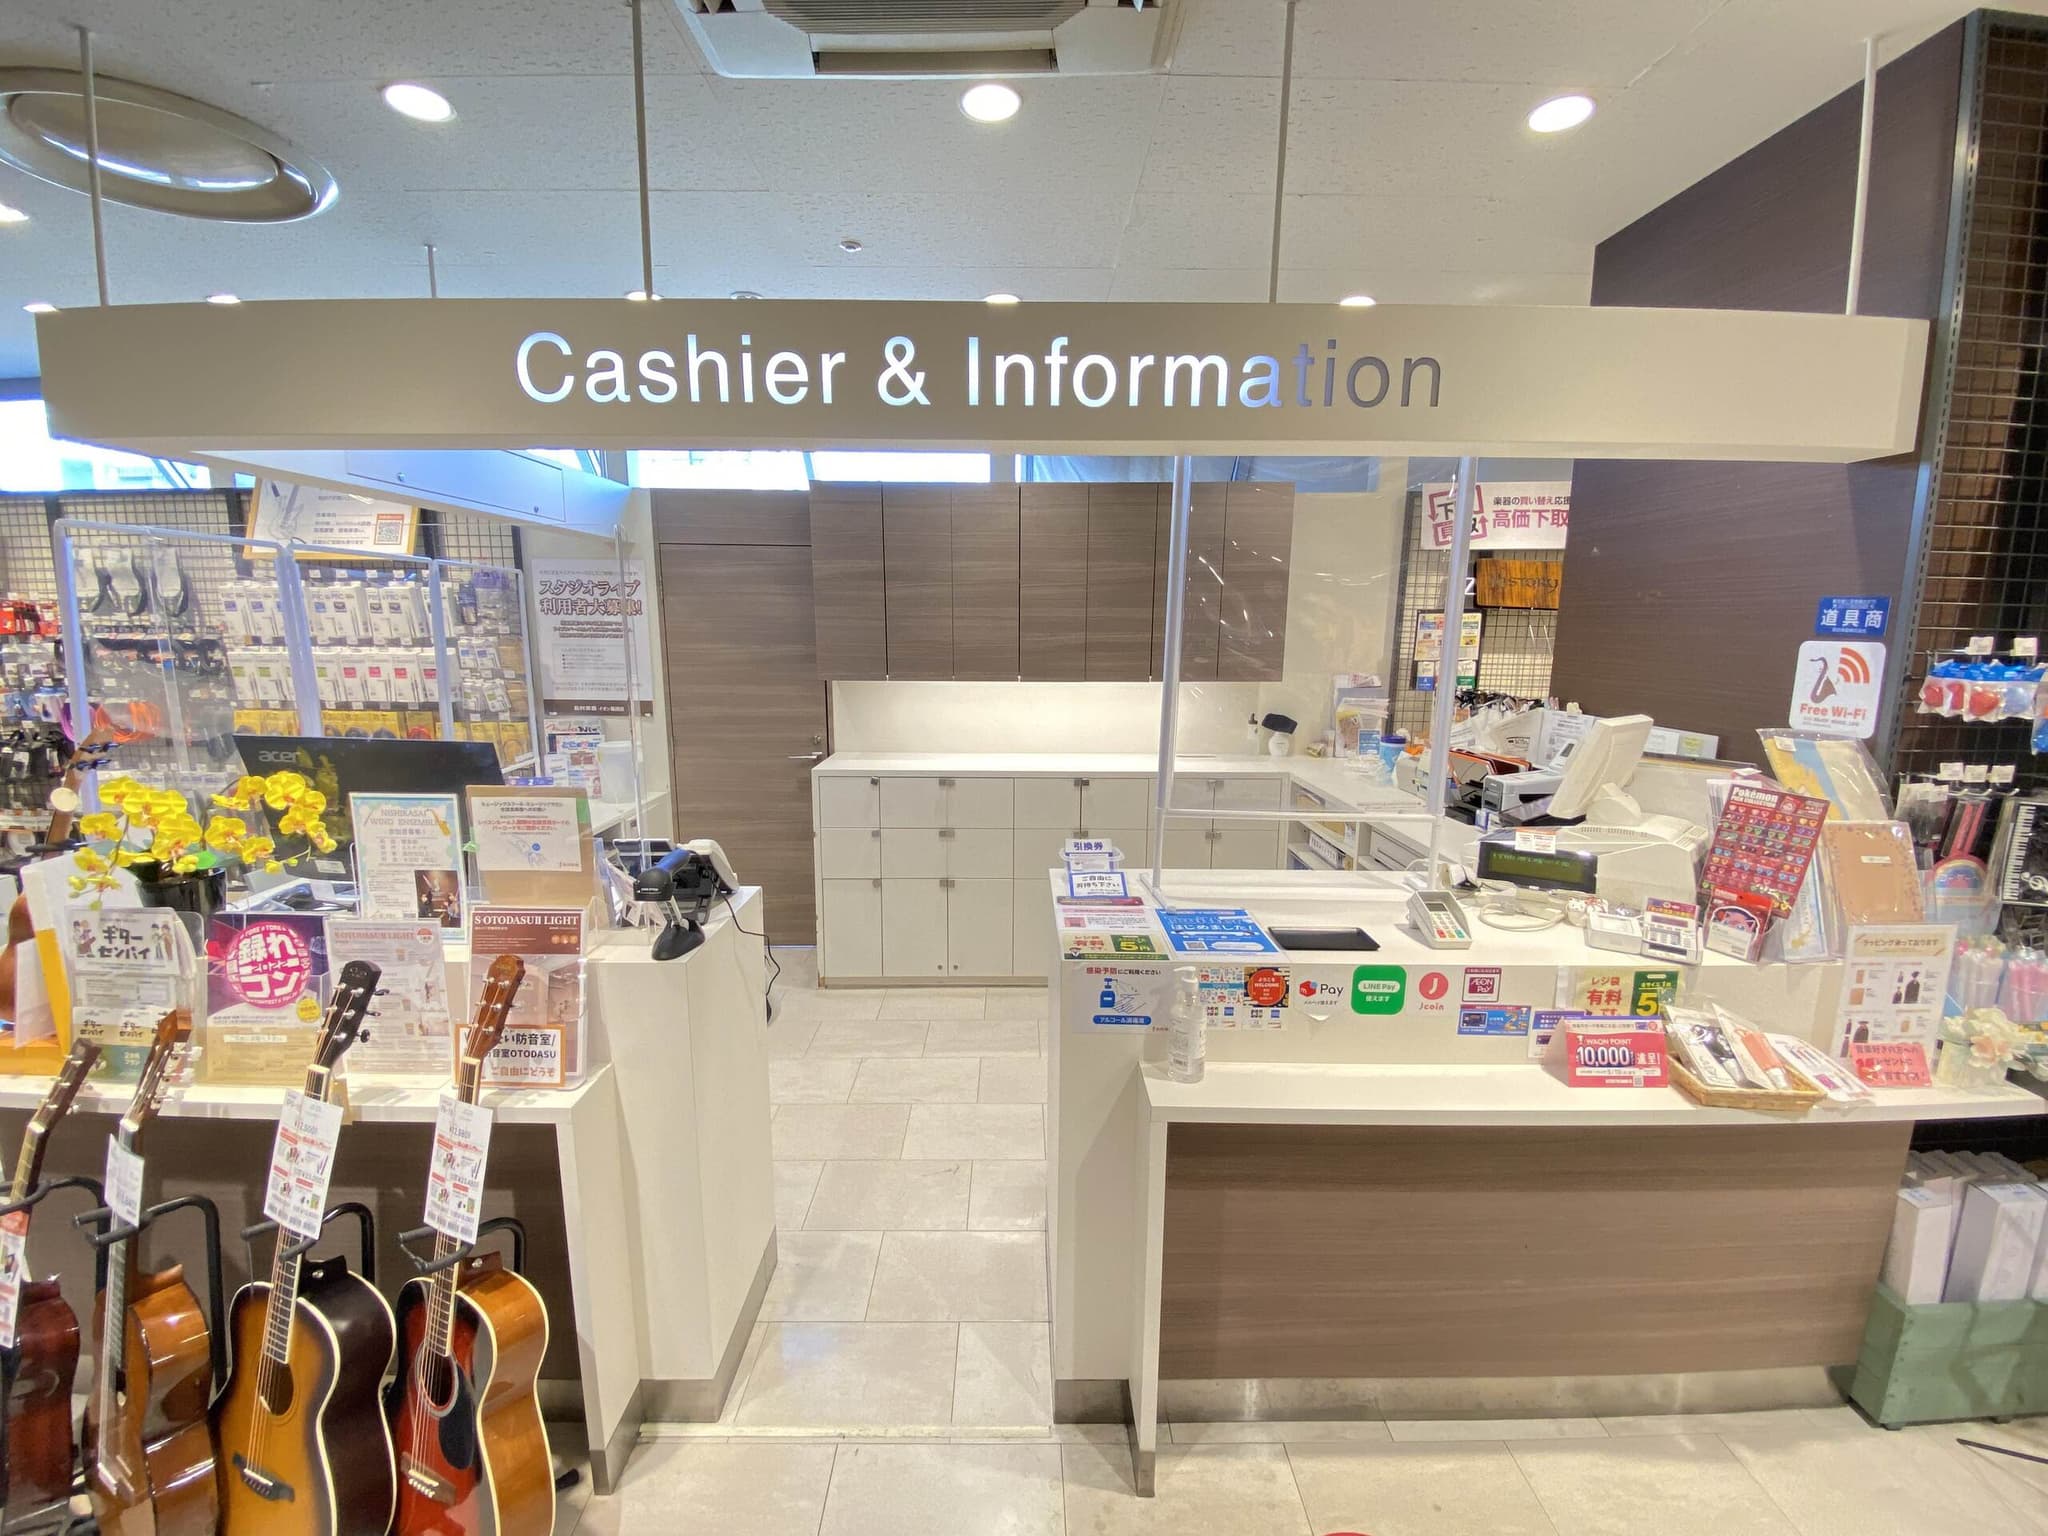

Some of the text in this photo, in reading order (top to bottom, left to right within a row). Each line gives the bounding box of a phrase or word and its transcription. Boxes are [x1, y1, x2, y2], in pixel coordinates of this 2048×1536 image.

[516, 332, 1441, 408] Cashier & Information
[1820, 608, 1884, 628] 道具商
[1800, 703, 1867, 720] Free Wi-Fi
[258, 750, 303, 762] acer
[1732, 787, 1778, 803] Pokémon
[1073, 841, 1103, 851] 引換券
[544, 915, 578, 925] LIGHT
[102, 925, 144, 944] ギター
[97, 946, 150, 960] センパイ
[1320, 983, 1344, 997] Pay
[1382, 983, 1396, 991] Pay
[1587, 989, 1622, 1005] 有料
[1636, 993, 1658, 1016] 5
[1577, 1046, 1630, 1067] 10,000
